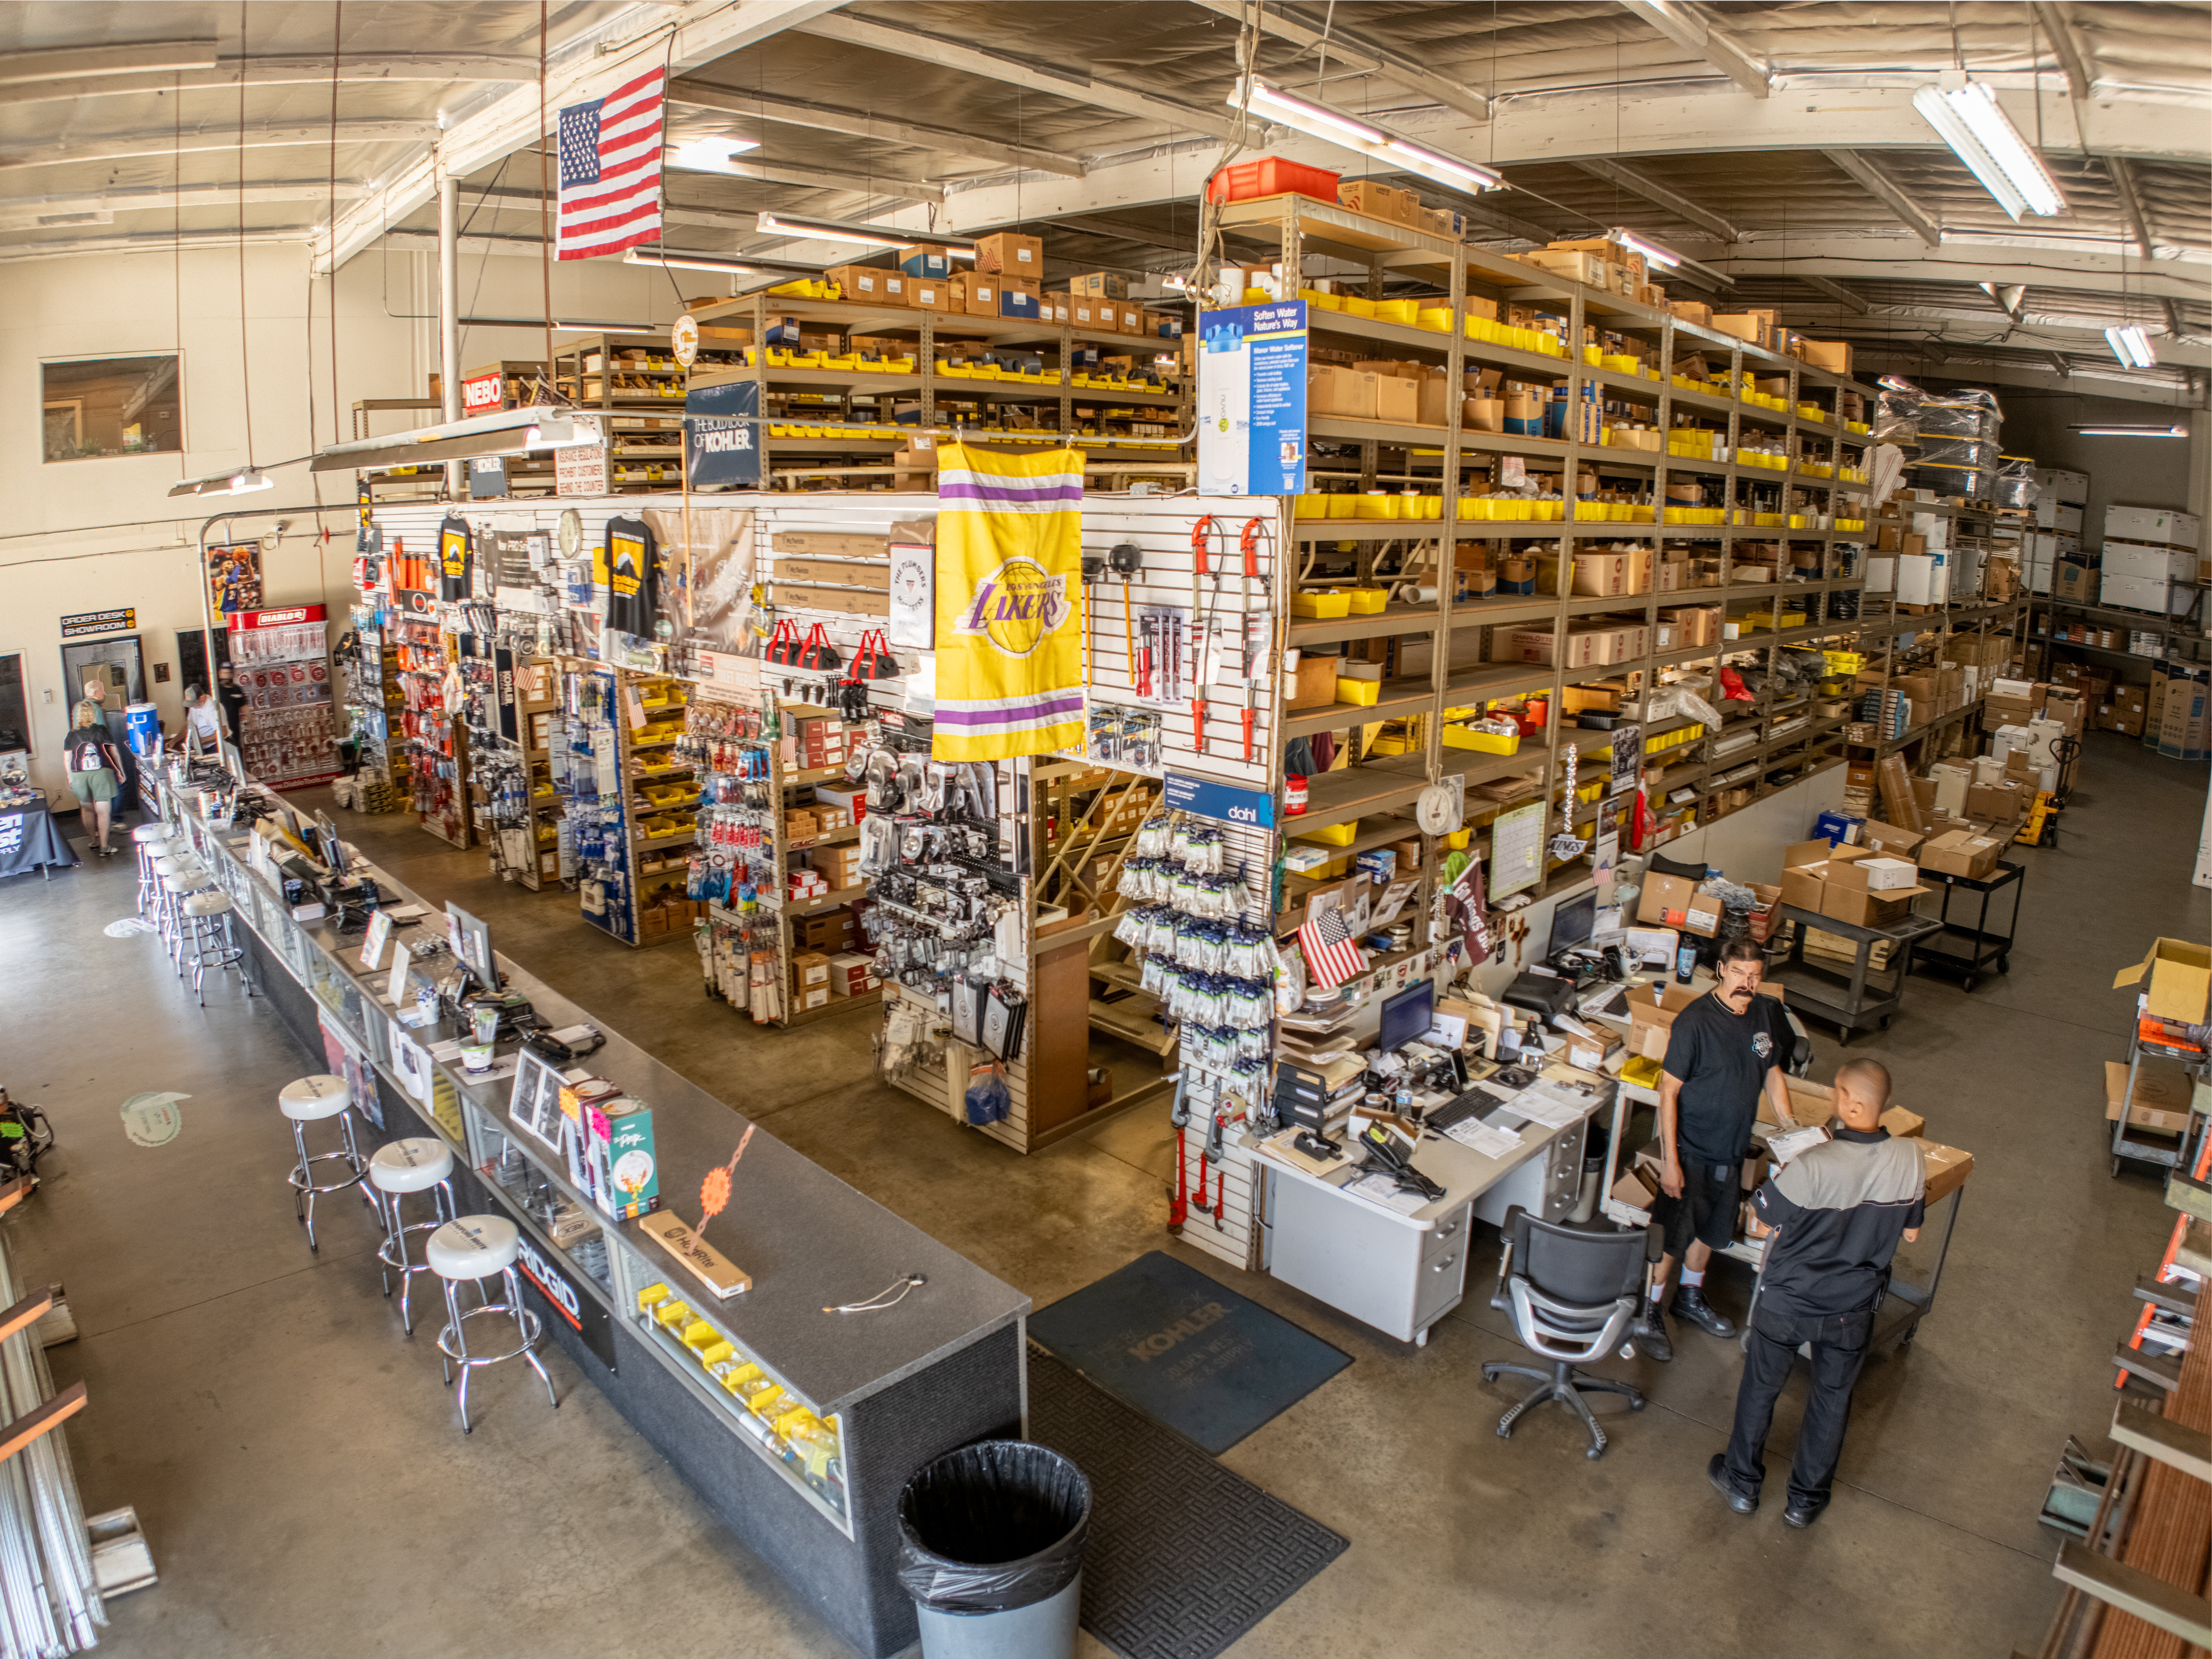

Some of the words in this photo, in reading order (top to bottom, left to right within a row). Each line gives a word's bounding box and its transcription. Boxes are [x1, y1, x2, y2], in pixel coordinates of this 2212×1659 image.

[1254, 310, 1275, 321] Soften
[1276, 308, 1298, 319] Water
[1254, 320, 1281, 331] Nature's
[1283, 318, 1298, 329] Way
[466, 378, 501, 407] NEBO
[694, 419, 708, 433] THE
[694, 434, 705, 449] OF
[704, 429, 751, 453] KOHLER
[557, 450, 577, 464] INSURANCE
[559, 467, 576, 478] PROHIBIT
[578, 464, 603, 477] CUSTOMERS
[559, 483, 573, 494] BEHIND
[574, 481, 583, 493] THE
[583, 480, 604, 492] COUNTER
[894, 566, 903, 584] THE
[902, 560, 926, 588] PLUMBERS
[1005, 583, 1022, 591] LOS
[1024, 579, 1062, 590] ANGELES
[962, 583, 1063, 629] LAKERS
[63, 615, 97, 625] ORDER
[98, 611, 126, 620] DESK
[261, 611, 294, 623] DIABLO
[64, 622, 126, 635] SHOWROOM
[1511, 634, 1553, 642] CHARLOTTE
[503, 671, 514, 704] KOHLER
[1228, 806, 1257, 823] dahl
[790, 837, 816, 849] GMC
[1453, 881, 1472, 901] Go
[451, 1220, 473, 1238] BRADFORD
[471, 1236, 487, 1250] WHITE
[565, 1222, 584, 1234] REX
[518, 1235, 580, 1316] RIDGID
[1129, 1302, 1232, 1362] KOHLER
